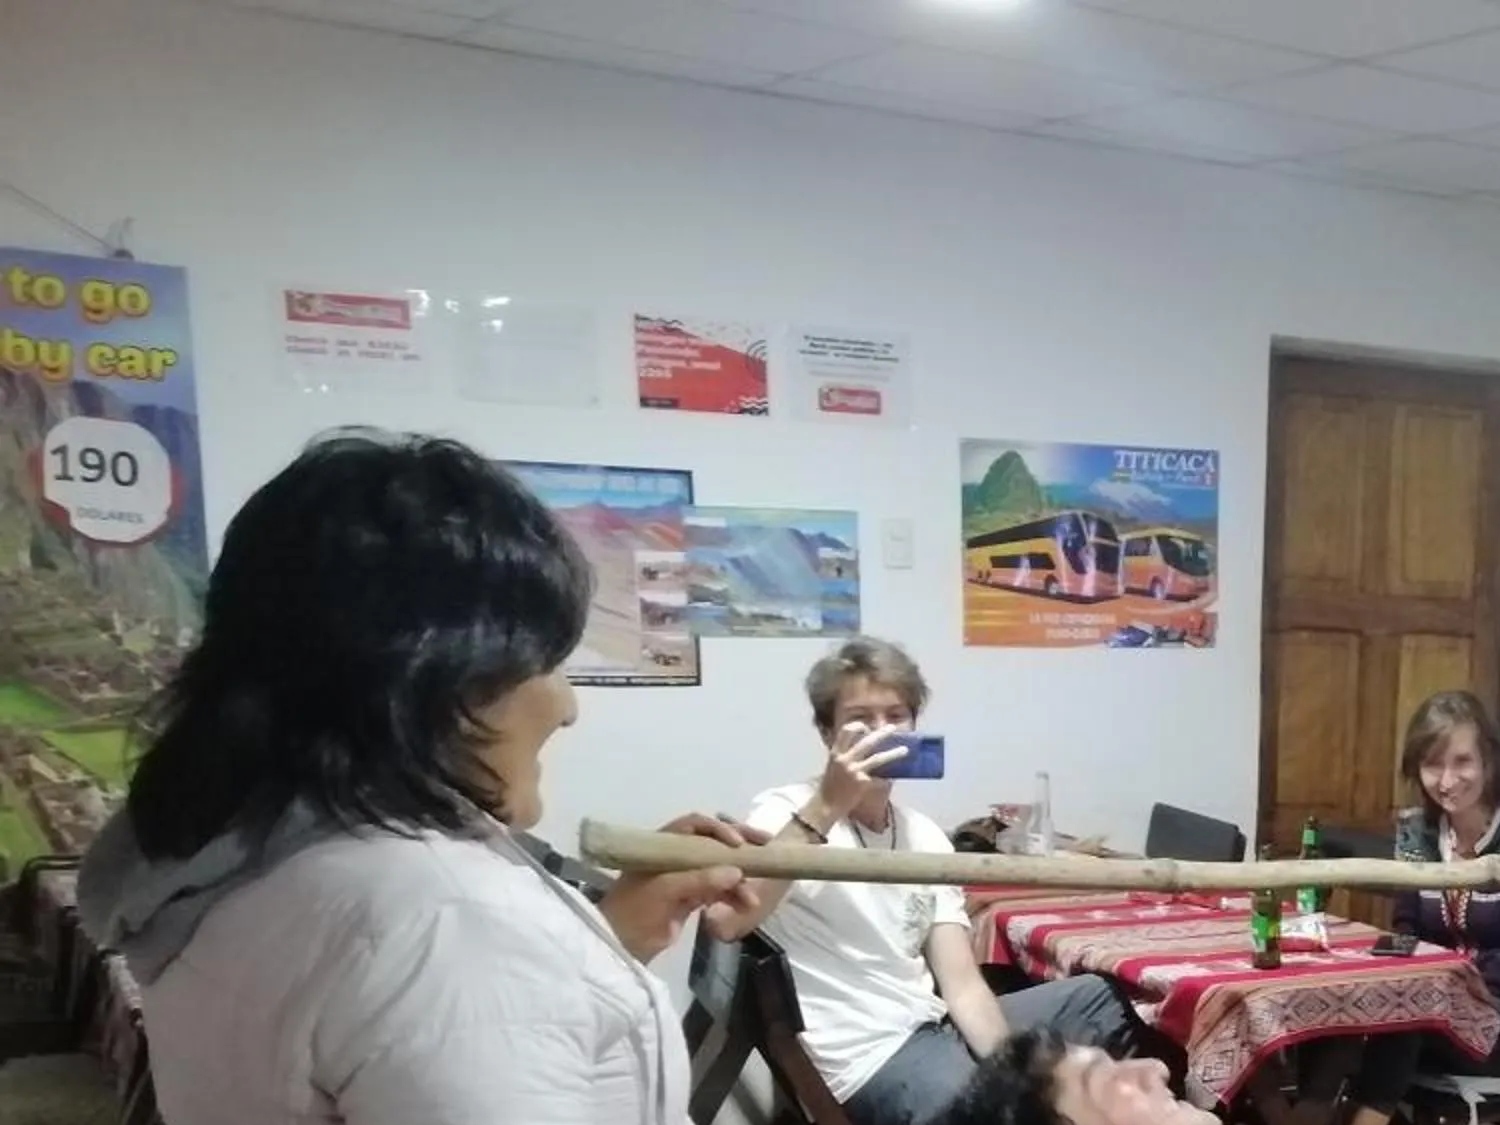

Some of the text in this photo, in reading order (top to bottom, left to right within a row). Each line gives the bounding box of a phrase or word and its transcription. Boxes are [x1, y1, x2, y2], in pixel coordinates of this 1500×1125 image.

[8, 266, 151, 323] to go
[1, 327, 177, 381] by car
[51, 445, 139, 487] 190
